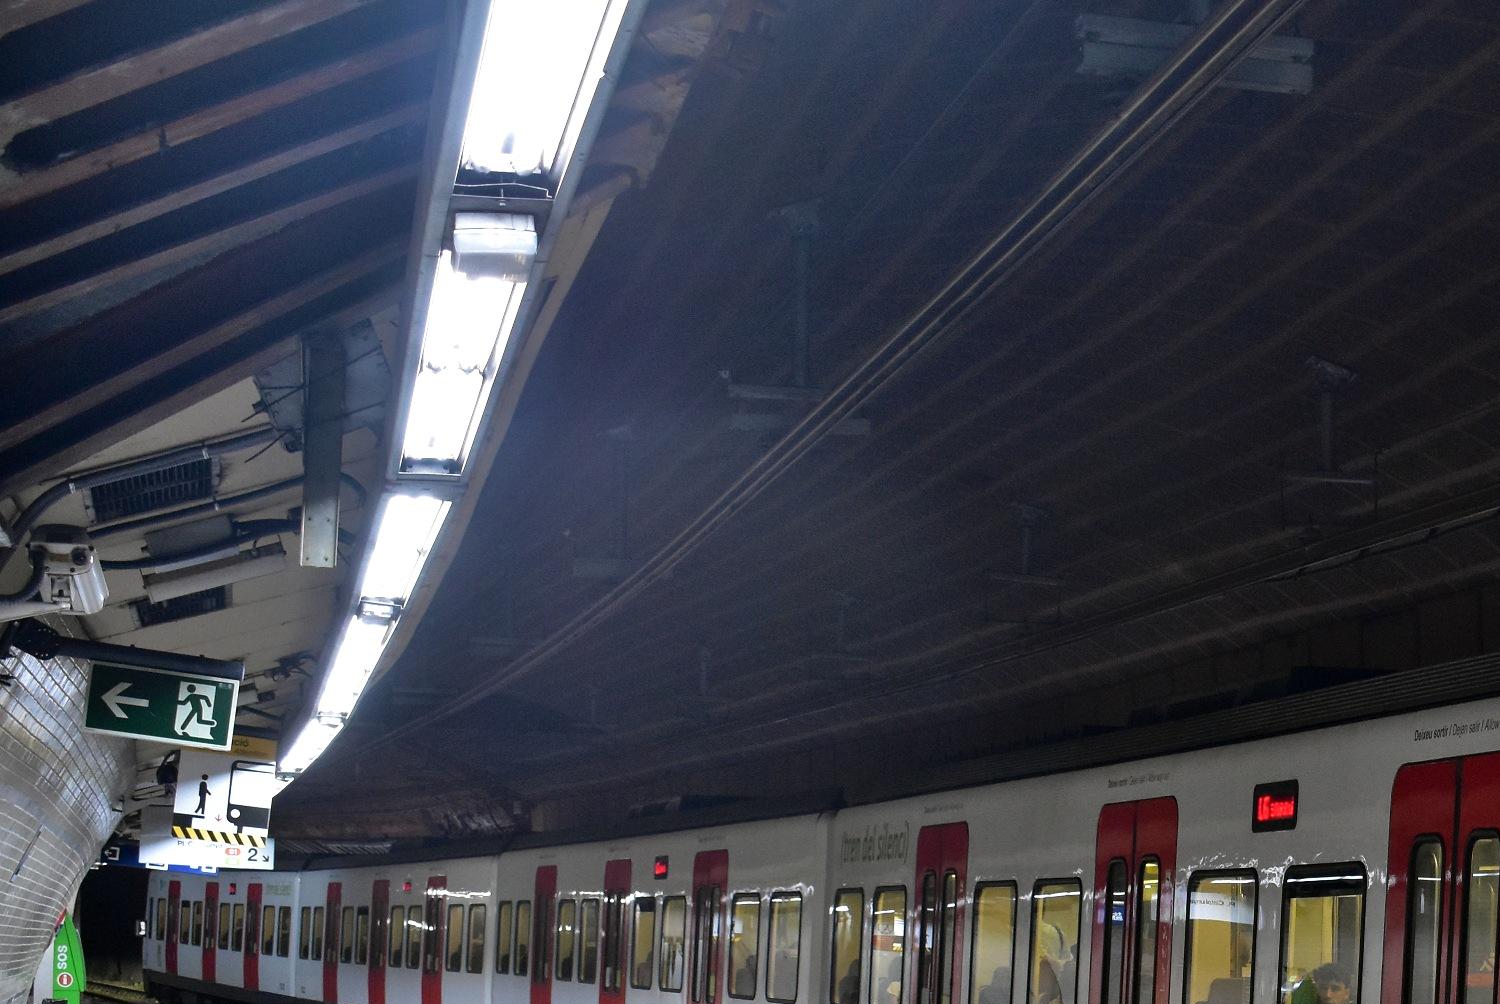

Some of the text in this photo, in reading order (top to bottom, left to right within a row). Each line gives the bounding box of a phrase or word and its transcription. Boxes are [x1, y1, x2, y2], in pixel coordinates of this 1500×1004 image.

[1414, 729, 1433, 742] Deixeu
[1433, 726, 1449, 739] sortir
[1484, 718, 1500, 731] Allow
[247, 847, 258, 862] 2
[57, 944, 68, 970] SOS
